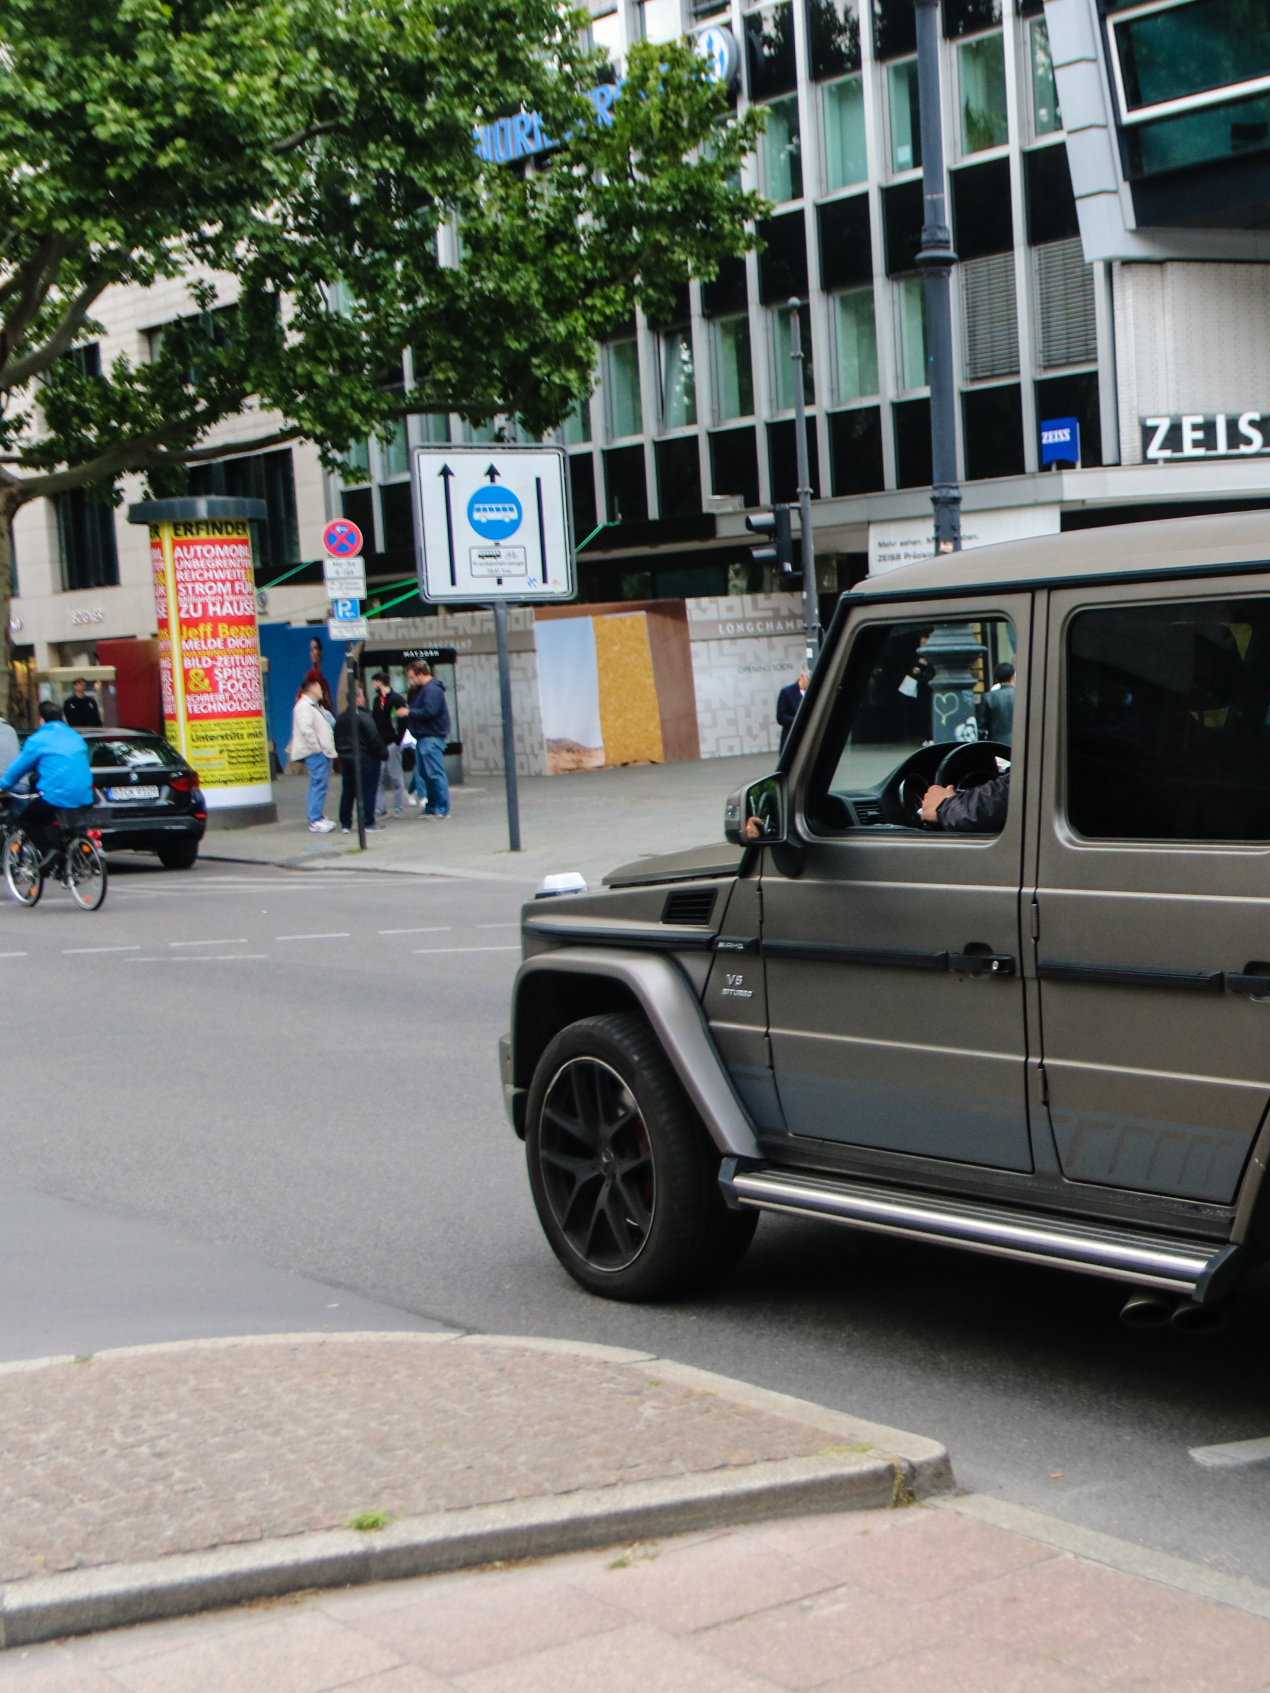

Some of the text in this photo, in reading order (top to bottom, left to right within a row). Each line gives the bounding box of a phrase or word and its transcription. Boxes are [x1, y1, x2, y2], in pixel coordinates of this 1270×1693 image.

[1041, 428, 1071, 444] ZEISS
[877, 552, 901, 562] ZEISS
[176, 569, 246, 582] REICHWEITE
[178, 581, 232, 596] STROM
[179, 604, 202, 618] ZU
[208, 601, 255, 616] HAUSE
[181, 623, 213, 639] Jeff
[218, 623, 256, 637] Bezos
[718, 619, 804, 635] LONGCHAMP
[182, 639, 224, 650] MELDE
[183, 656, 259, 669] BILD-ZEITUNG
[737, 664, 771, 674] OPENING
[773, 662, 794, 672] SOON
[188, 668, 212, 693] &
[213, 666, 260, 682] SPIEGEL
[217, 679, 261, 695] FOCUS
[185, 693, 231, 704] SCHREIBT
[726, 974, 743, 985] V8
[722, 988, 753, 997] BITURBO
